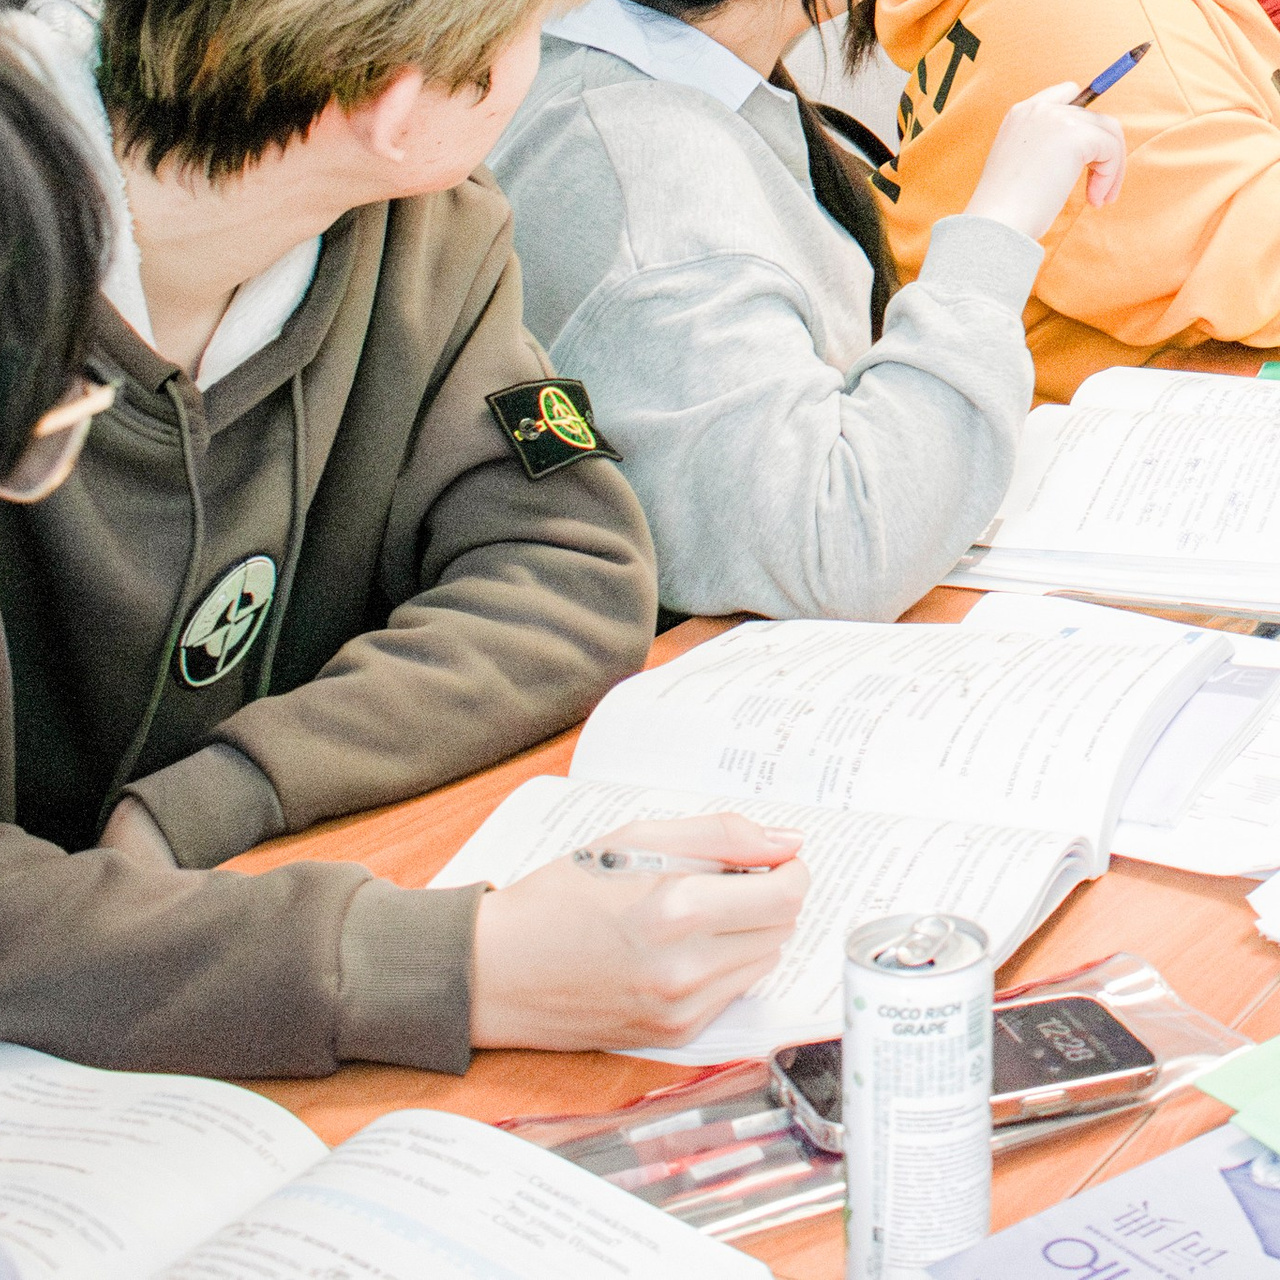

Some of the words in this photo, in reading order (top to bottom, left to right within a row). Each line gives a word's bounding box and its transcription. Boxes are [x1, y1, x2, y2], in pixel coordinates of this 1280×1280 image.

[878, 1004, 921, 1020] COCO
[923, 1002, 962, 1018] RICH
[892, 1021, 948, 1037] GRAPE
